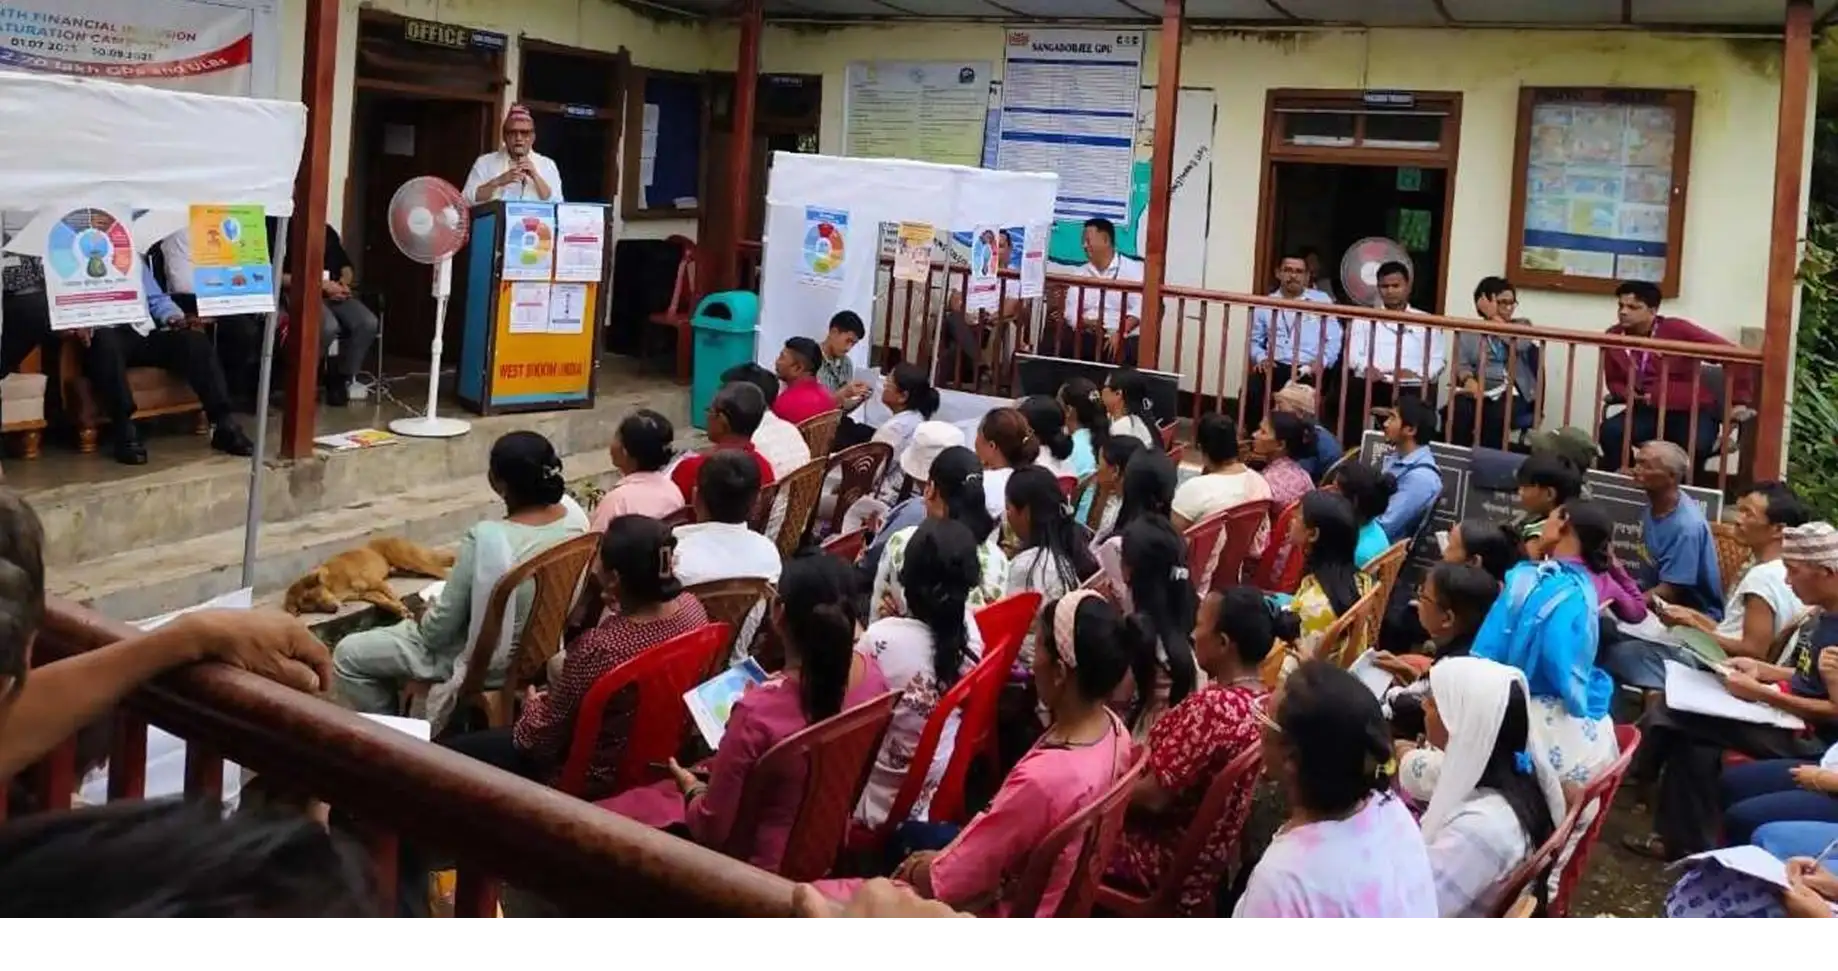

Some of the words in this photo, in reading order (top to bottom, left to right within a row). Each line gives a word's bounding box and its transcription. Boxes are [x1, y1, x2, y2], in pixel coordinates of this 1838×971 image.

[33, 12, 116, 31] FINANCIAL
[407, 21, 467, 46] OFFICE
[500, 363, 523, 379] WEST
